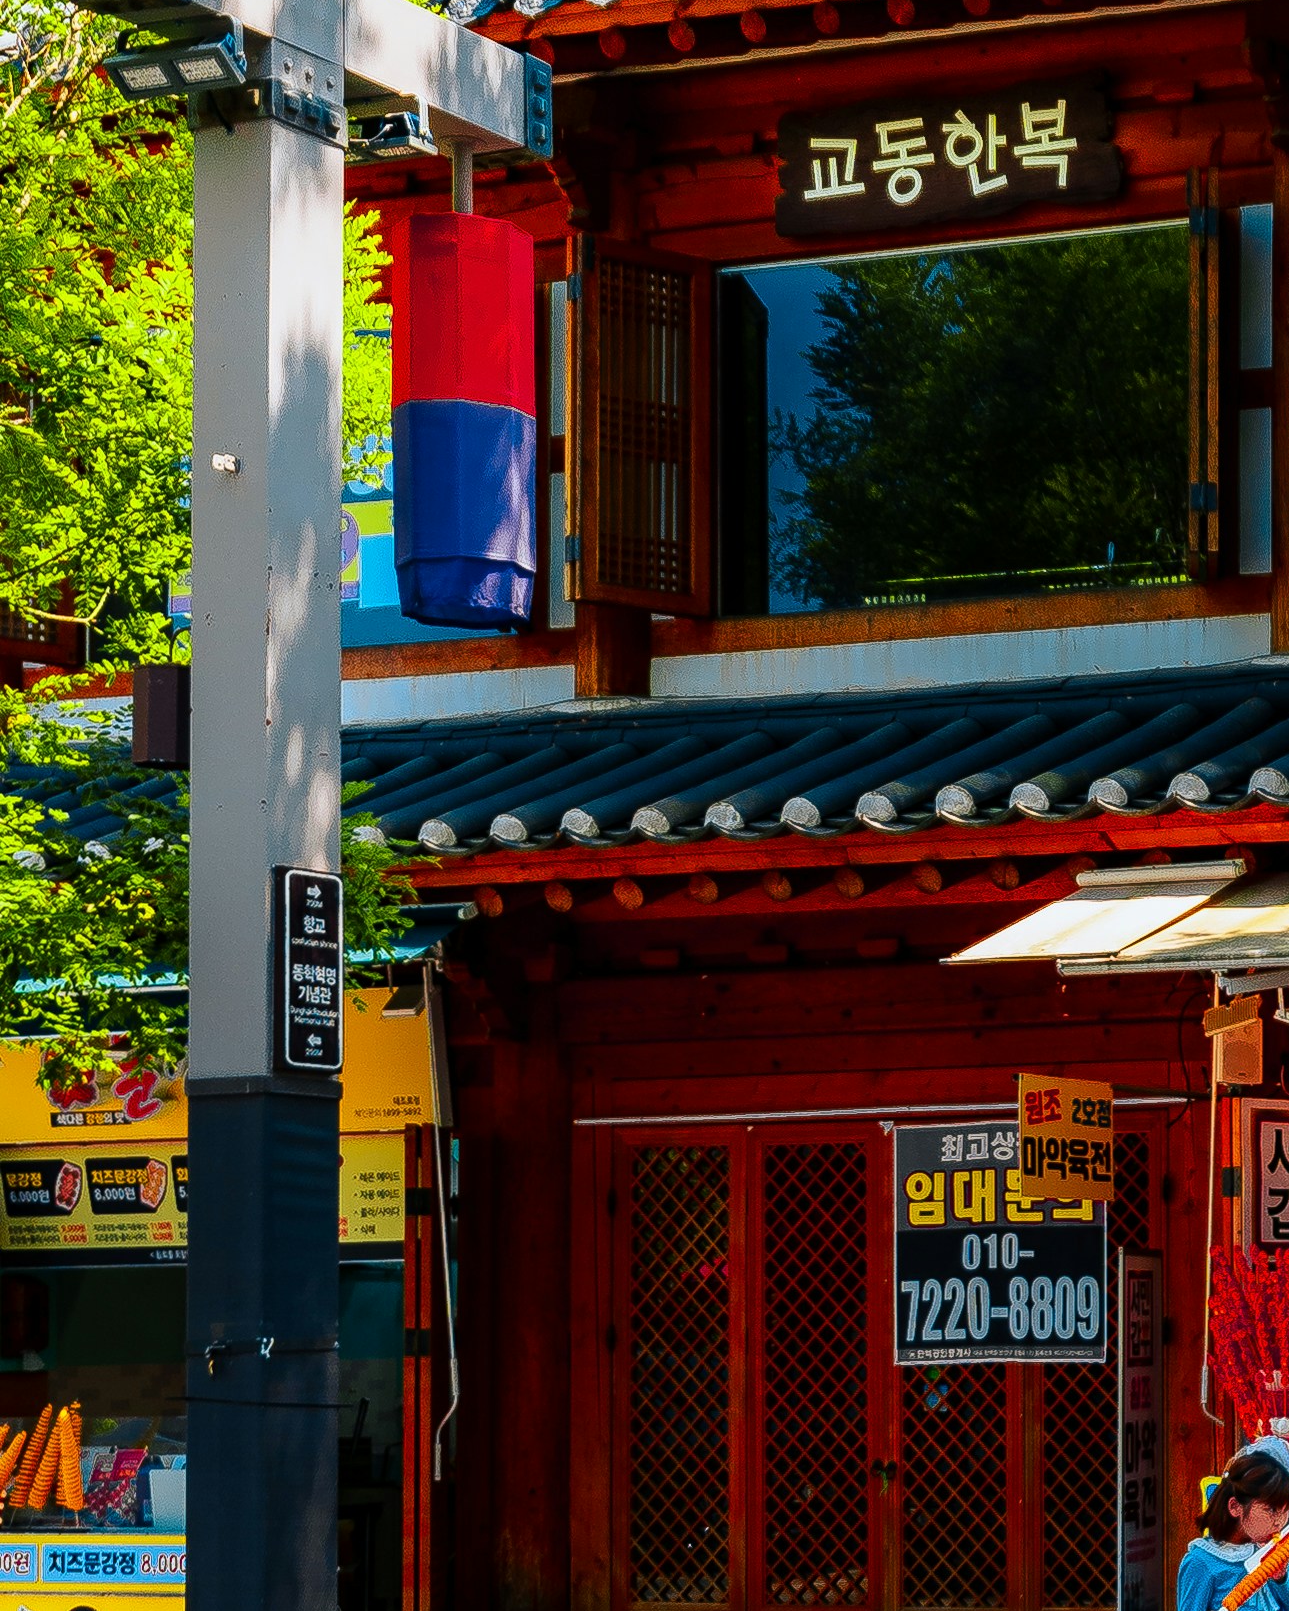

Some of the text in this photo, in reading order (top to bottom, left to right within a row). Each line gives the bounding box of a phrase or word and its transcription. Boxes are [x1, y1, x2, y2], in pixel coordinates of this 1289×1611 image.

[803, 99, 1078, 206] 교동한복
[303, 914, 326, 934] 향교
[292, 963, 336, 986] 동학혁명
[298, 985, 332, 1005] 기념관
[1024, 1089, 1111, 1129] 원조 2호점
[941, 1131, 1019, 1162] 최고상
[1023, 1135, 1111, 1183] 마약육전
[962, 1232, 1035, 1270] 010-
[900, 1276, 1100, 1341] 7220-8809
[48, 1551, 136, 1576] 치즈문강정
